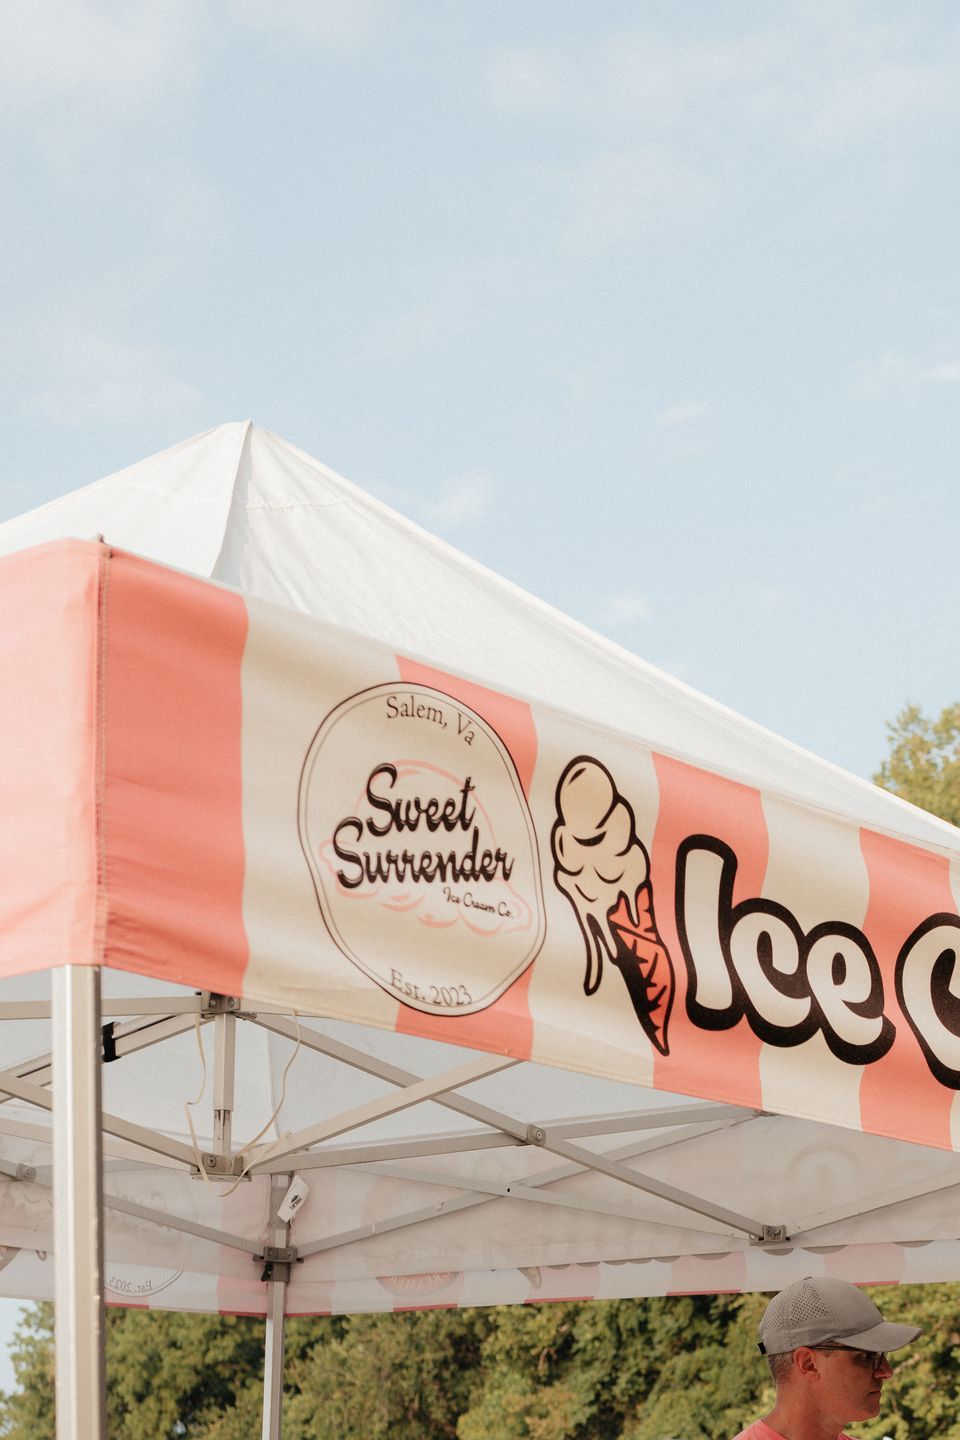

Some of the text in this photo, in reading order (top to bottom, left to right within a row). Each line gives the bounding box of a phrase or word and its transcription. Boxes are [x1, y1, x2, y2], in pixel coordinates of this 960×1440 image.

[386, 696, 476, 745] Salem, Va
[366, 763, 476, 836] Sweet
[333, 817, 515, 888] Surrender
[443, 886, 462, 903] Ice
[463, 892, 496, 914] Cream
[675, 834, 896, 1065] Ice
[390, 968, 472, 1006] Est. 2023
